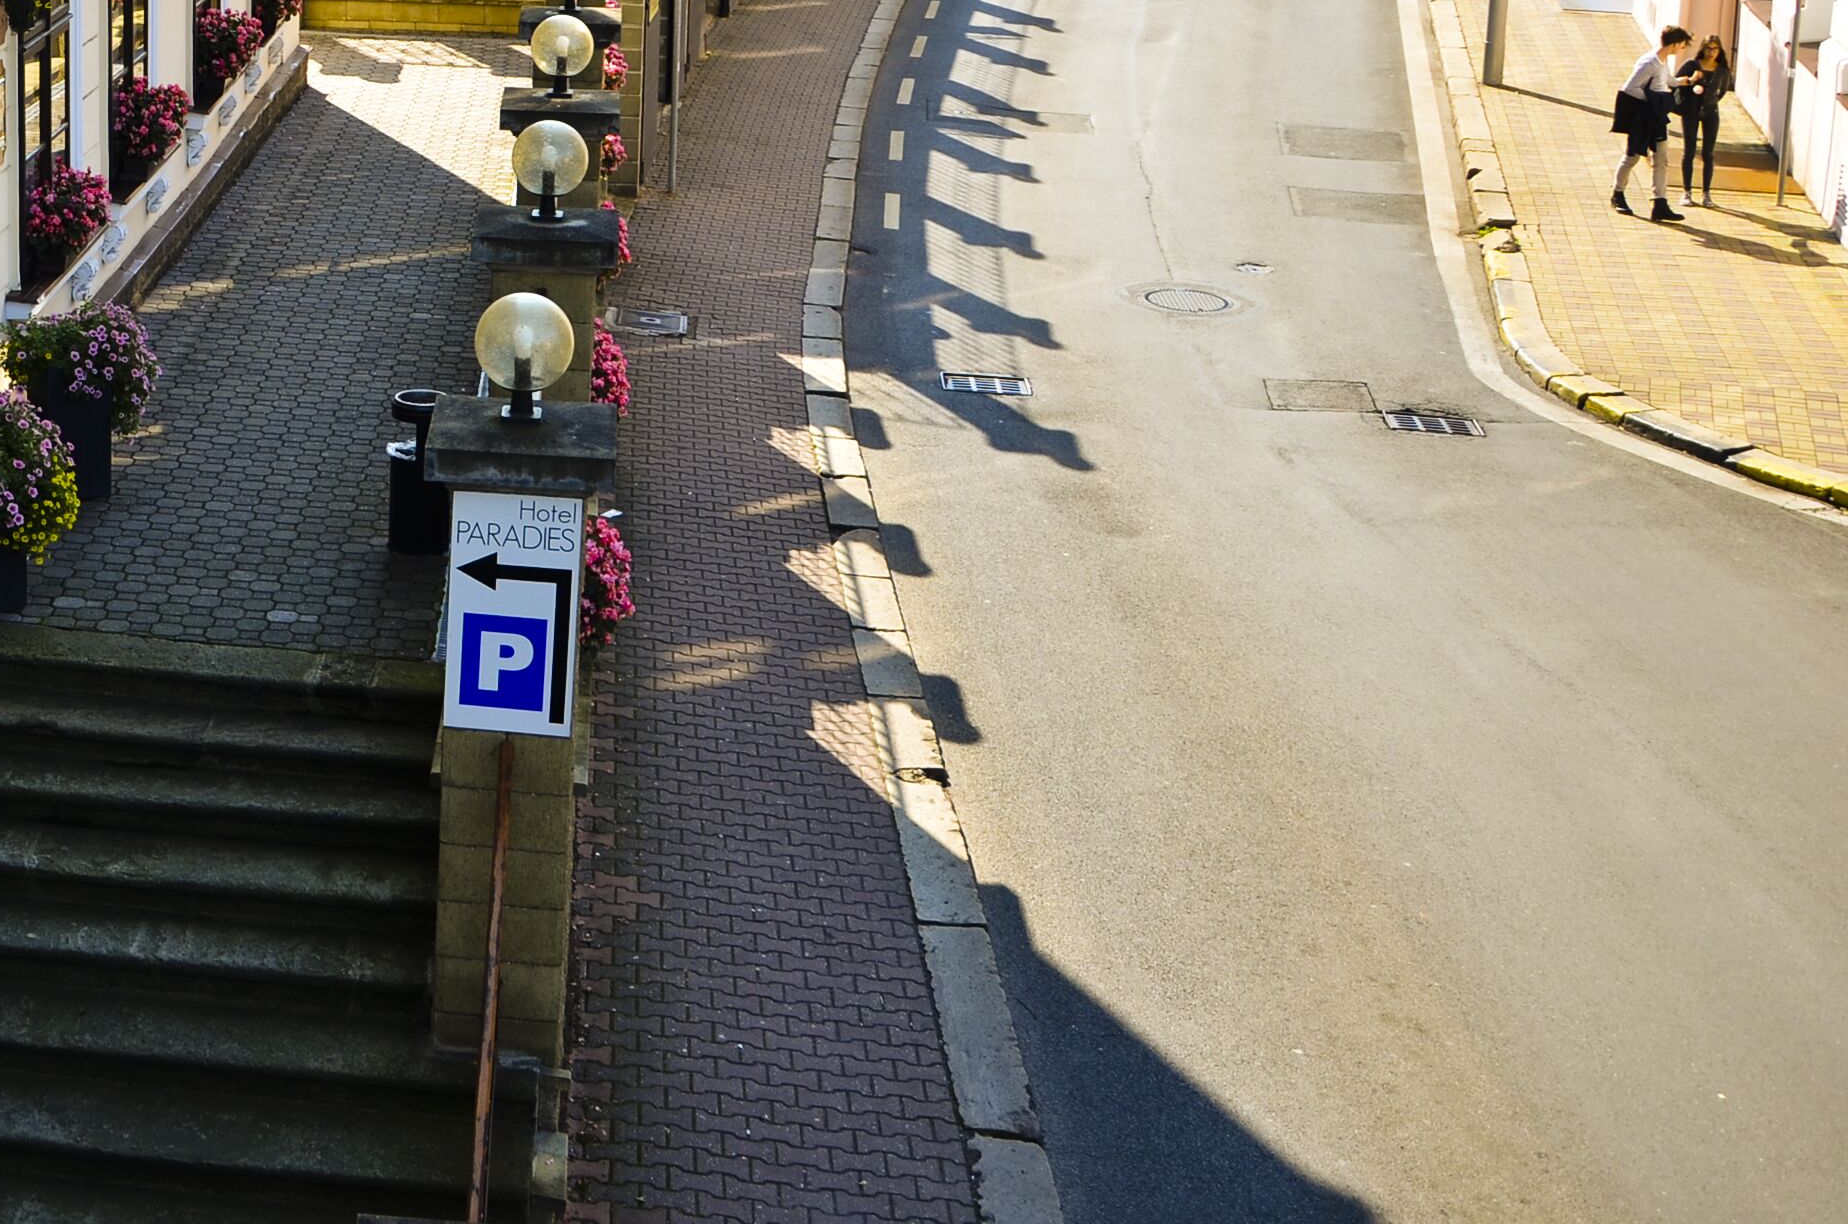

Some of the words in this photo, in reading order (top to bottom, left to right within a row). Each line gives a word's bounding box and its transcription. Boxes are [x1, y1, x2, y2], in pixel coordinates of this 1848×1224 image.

[519, 500, 577, 524] Hotel
[456, 520, 576, 553] PARADIES
[478, 631, 534, 692] P
